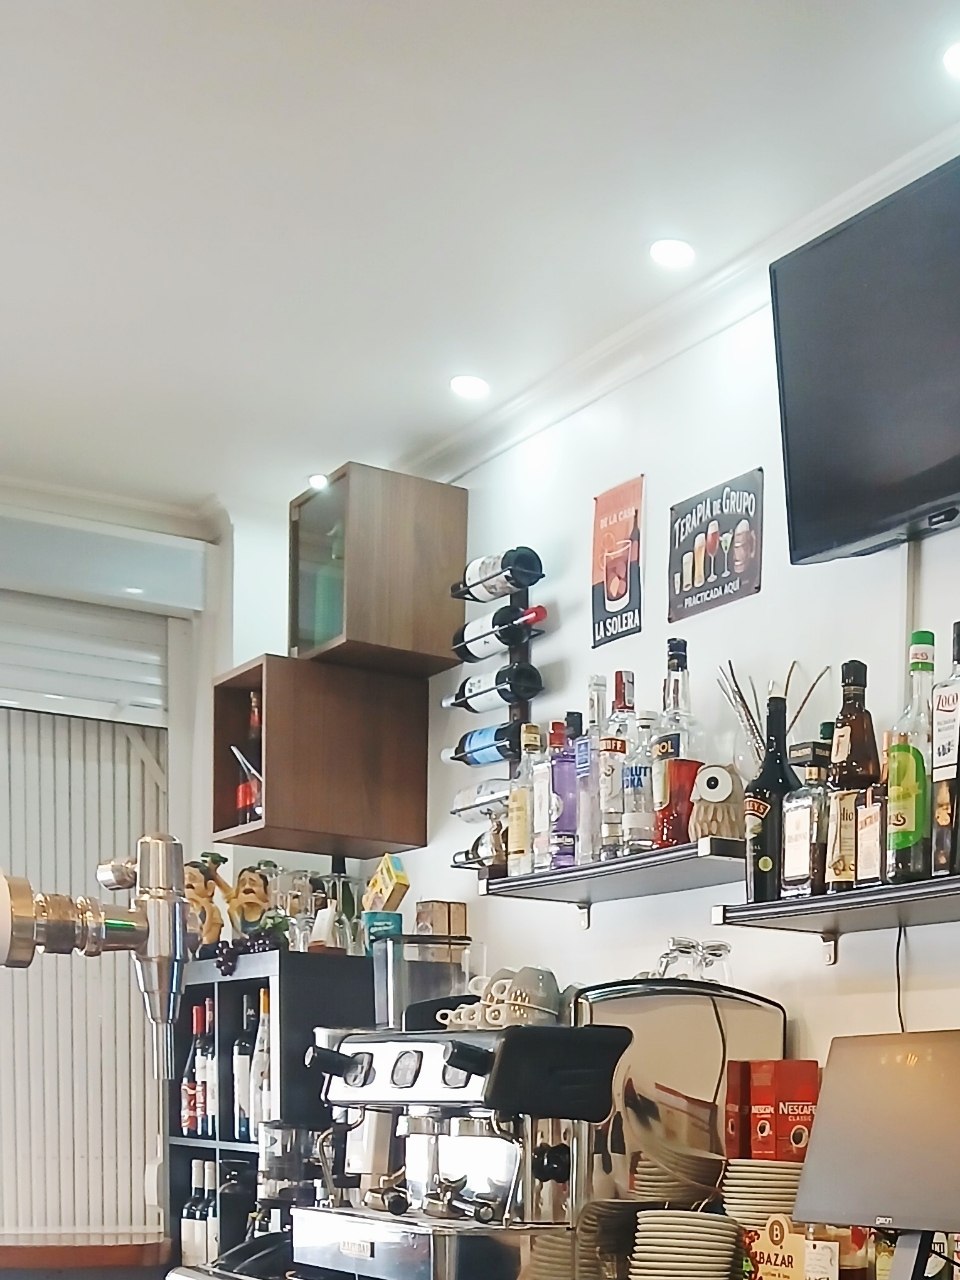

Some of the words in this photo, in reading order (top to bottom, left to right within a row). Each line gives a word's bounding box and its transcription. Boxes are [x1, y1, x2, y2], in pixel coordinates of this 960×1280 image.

[600, 516, 608, 529] DE
[608, 513, 618, 525] LA
[674, 498, 712, 549] TERAPIA
[713, 498, 722, 514] DE
[722, 486, 756, 518] GRUPO
[684, 588, 723, 609] PRACTICADA
[595, 620, 605, 641] LA
[605, 608, 640, 635] SOLERA
[758, 1251, 794, 1269] BAZAR
